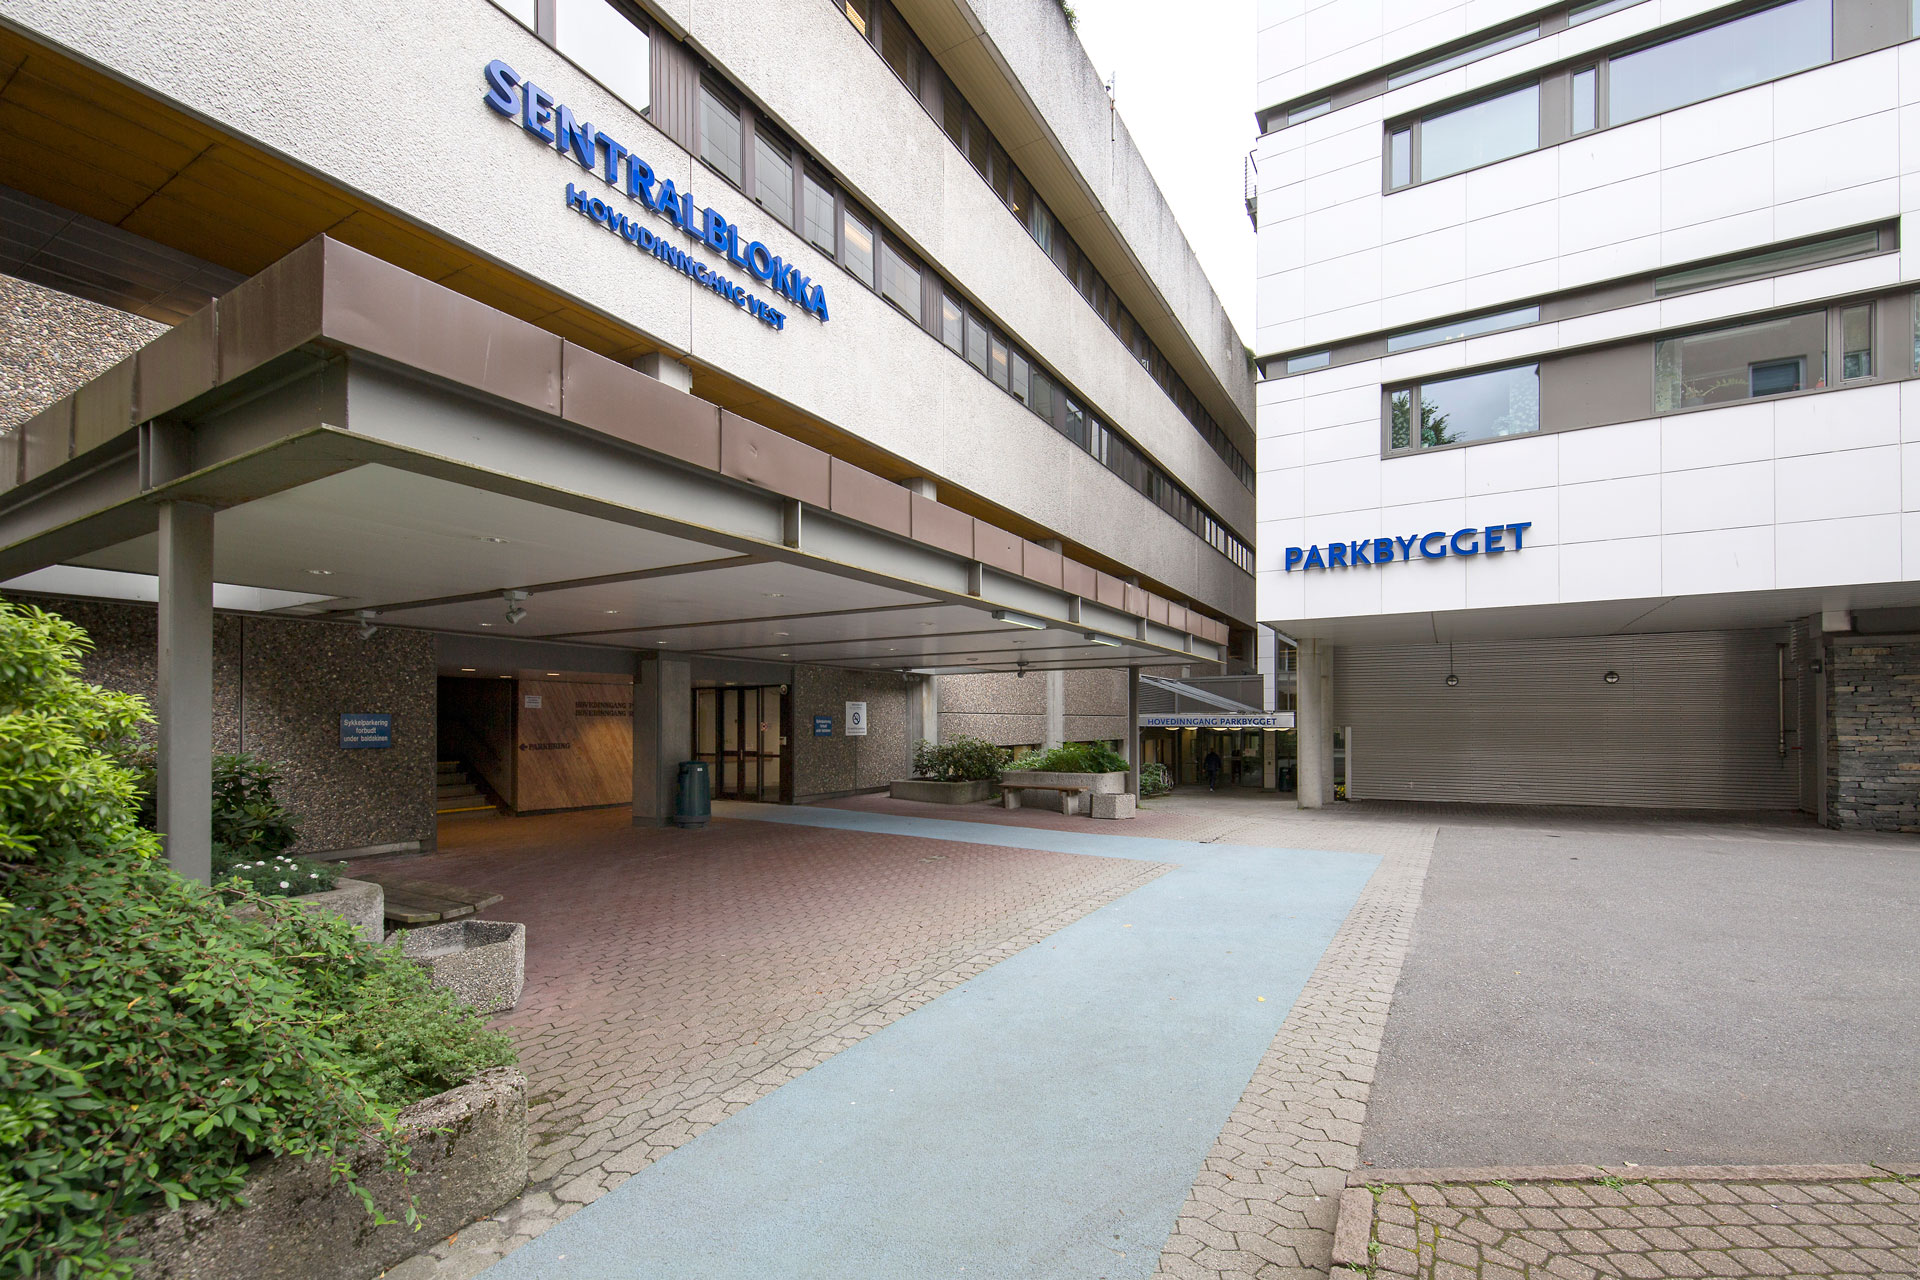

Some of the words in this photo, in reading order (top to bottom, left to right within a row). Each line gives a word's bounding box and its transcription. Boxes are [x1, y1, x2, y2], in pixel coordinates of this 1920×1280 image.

[484, 59, 830, 322] SENTRALBLOKKA
[566, 182, 746, 308] HOVUDINNGANG
[747, 294, 787, 331] VEST
[1285, 521, 1532, 572] PARKBYGGET
[343, 719, 388, 727] Sykkelparkering
[1147, 717, 1218, 726] HOVEDINNGANG
[1220, 717, 1277, 726] PARKBYGGET
[528, 742, 571, 751] PARKERING
